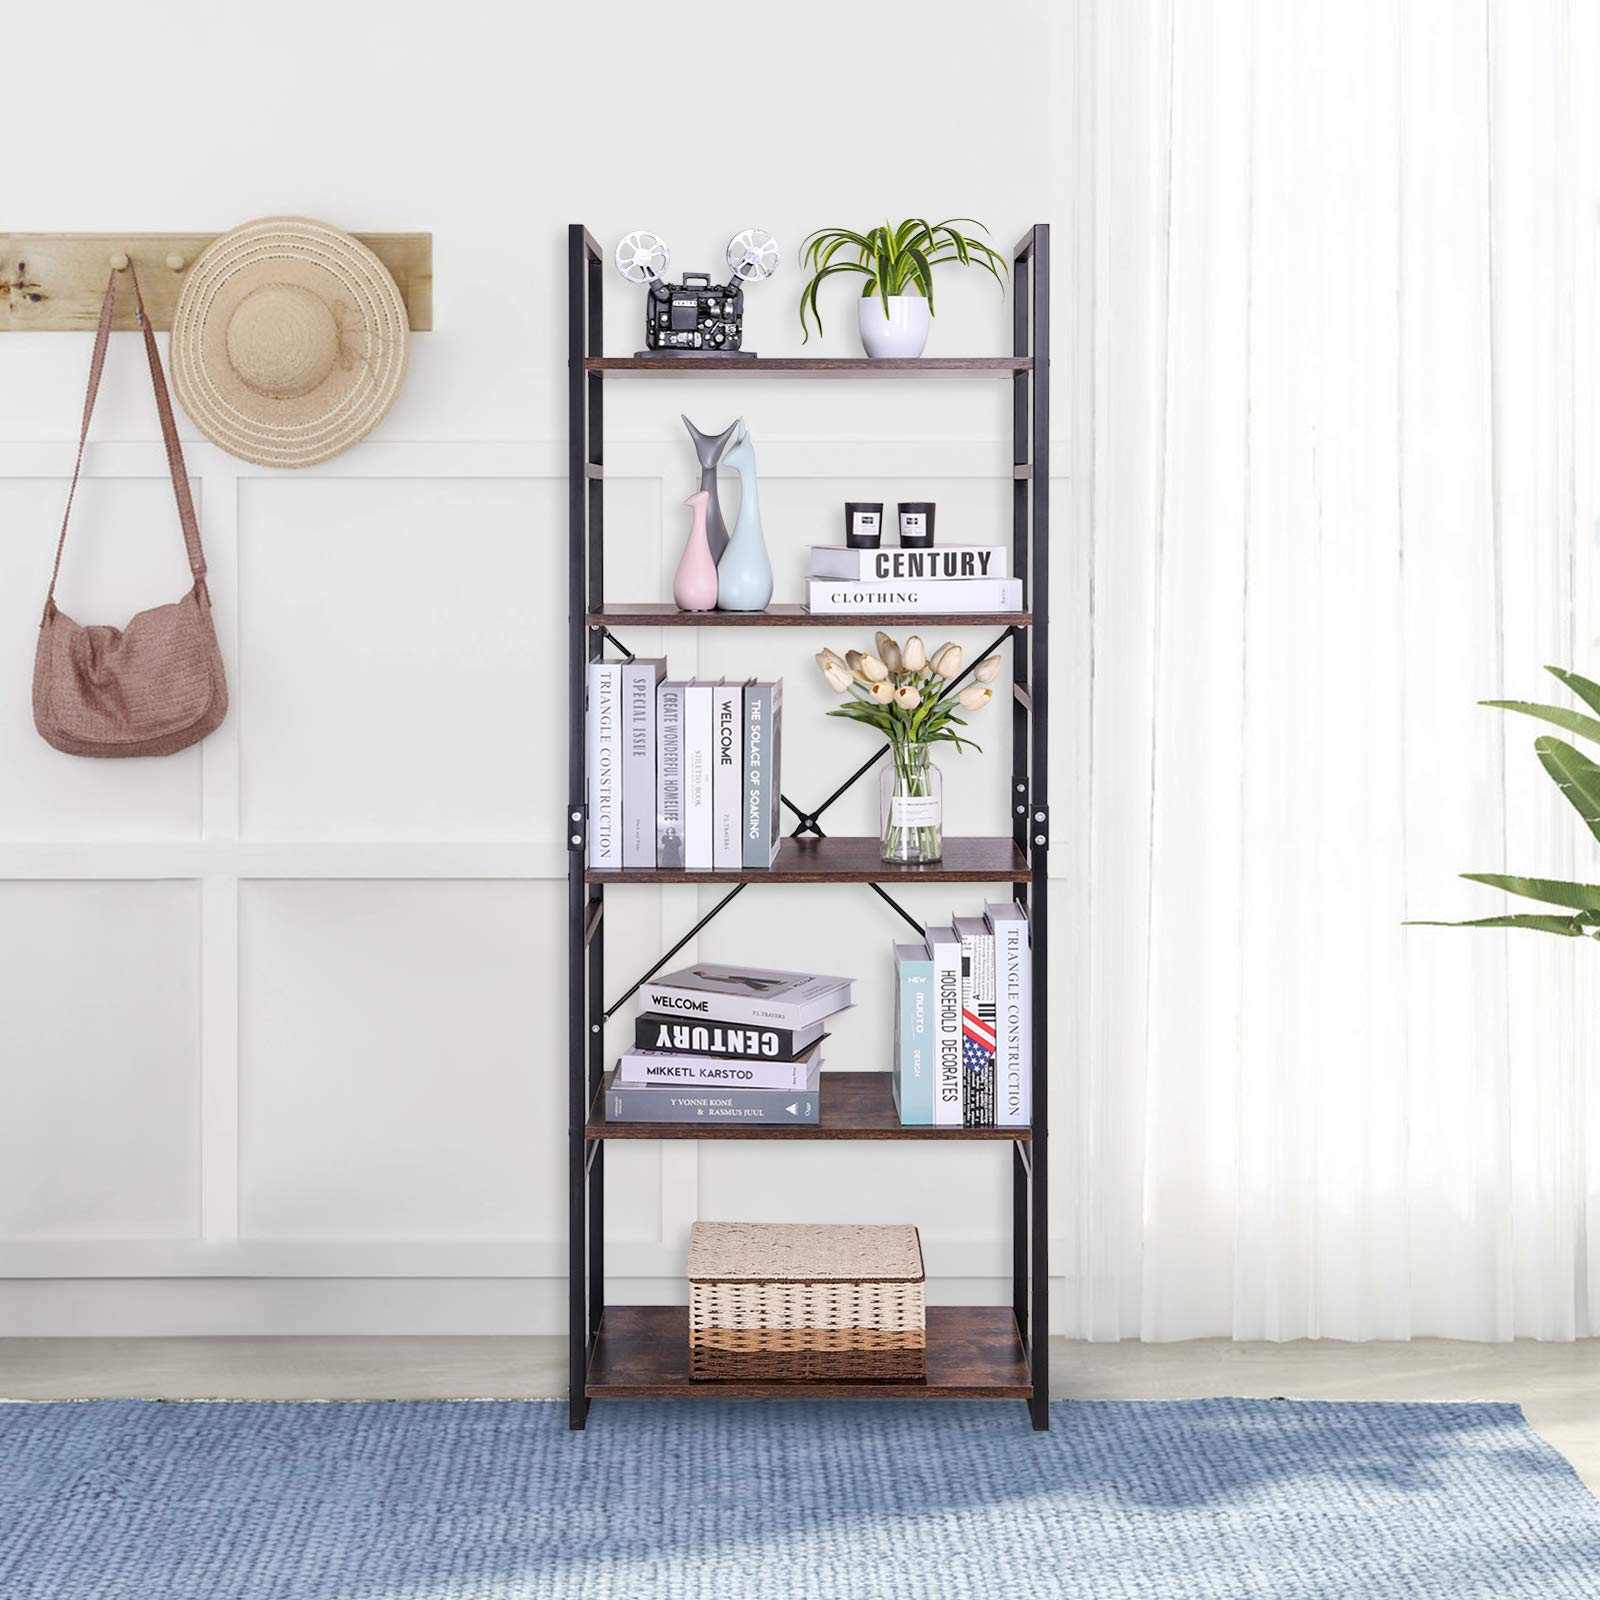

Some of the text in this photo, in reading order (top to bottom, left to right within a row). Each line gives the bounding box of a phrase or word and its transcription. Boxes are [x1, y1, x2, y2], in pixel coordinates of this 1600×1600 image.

[875, 551, 992, 579] CENTURY
[831, 592, 918, 604] CLOTHING
[632, 678, 646, 757] SPECIAL ISSUE
[720, 700, 732, 765] WELCOME
[599, 672, 612, 858] TRIANGLE CONSTRUCTION
[663, 692, 679, 822] CREATE WONDERFUL HOMELIFE
[749, 699, 761, 840] THE SOLACE OF SOAKING
[651, 994, 709, 1012] WELCOME
[1007, 927, 1020, 1117] TRIANGLE CONSTRUCTION
[656, 1024, 779, 1056] CENTURY
[940, 969, 958, 1102] HOUSEHOLD DECORATES
[646, 1066, 754, 1080] MIKKETL KARSTOD
[913, 1049, 921, 1077] DESIGN
[697, 1108, 765, 1117] & RASMUS JUUL
